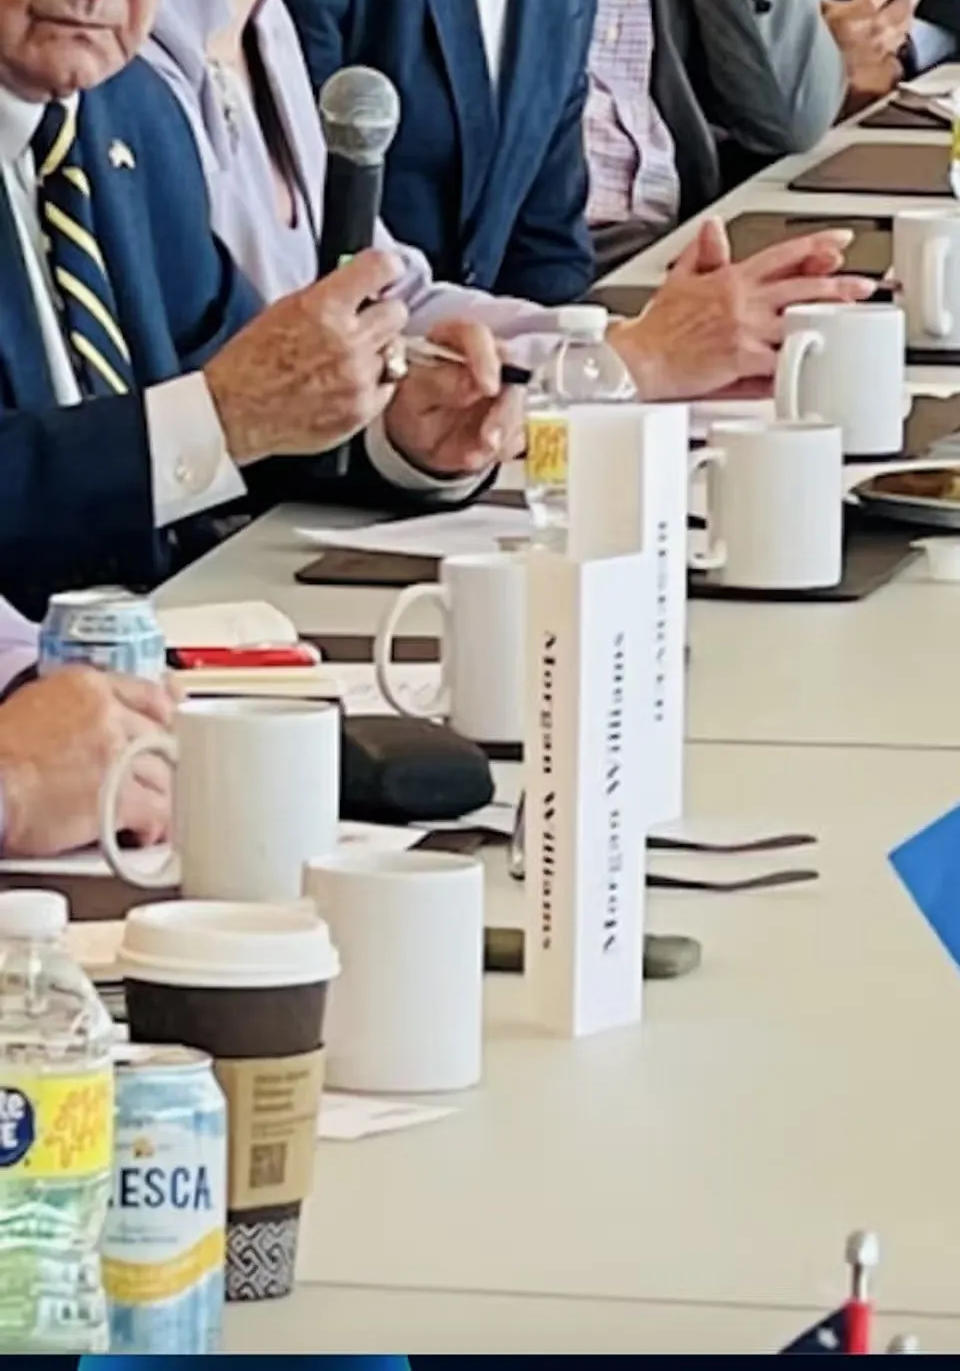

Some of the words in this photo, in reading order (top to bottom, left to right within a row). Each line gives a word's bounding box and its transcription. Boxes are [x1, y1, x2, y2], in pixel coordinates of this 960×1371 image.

[540, 630, 557, 775] Morgan
[605, 631, 624, 797] Williams
[541, 790, 557, 951] Williams
[602, 808, 622, 955] Morgan
[107, 1165, 212, 1210] ESCA
